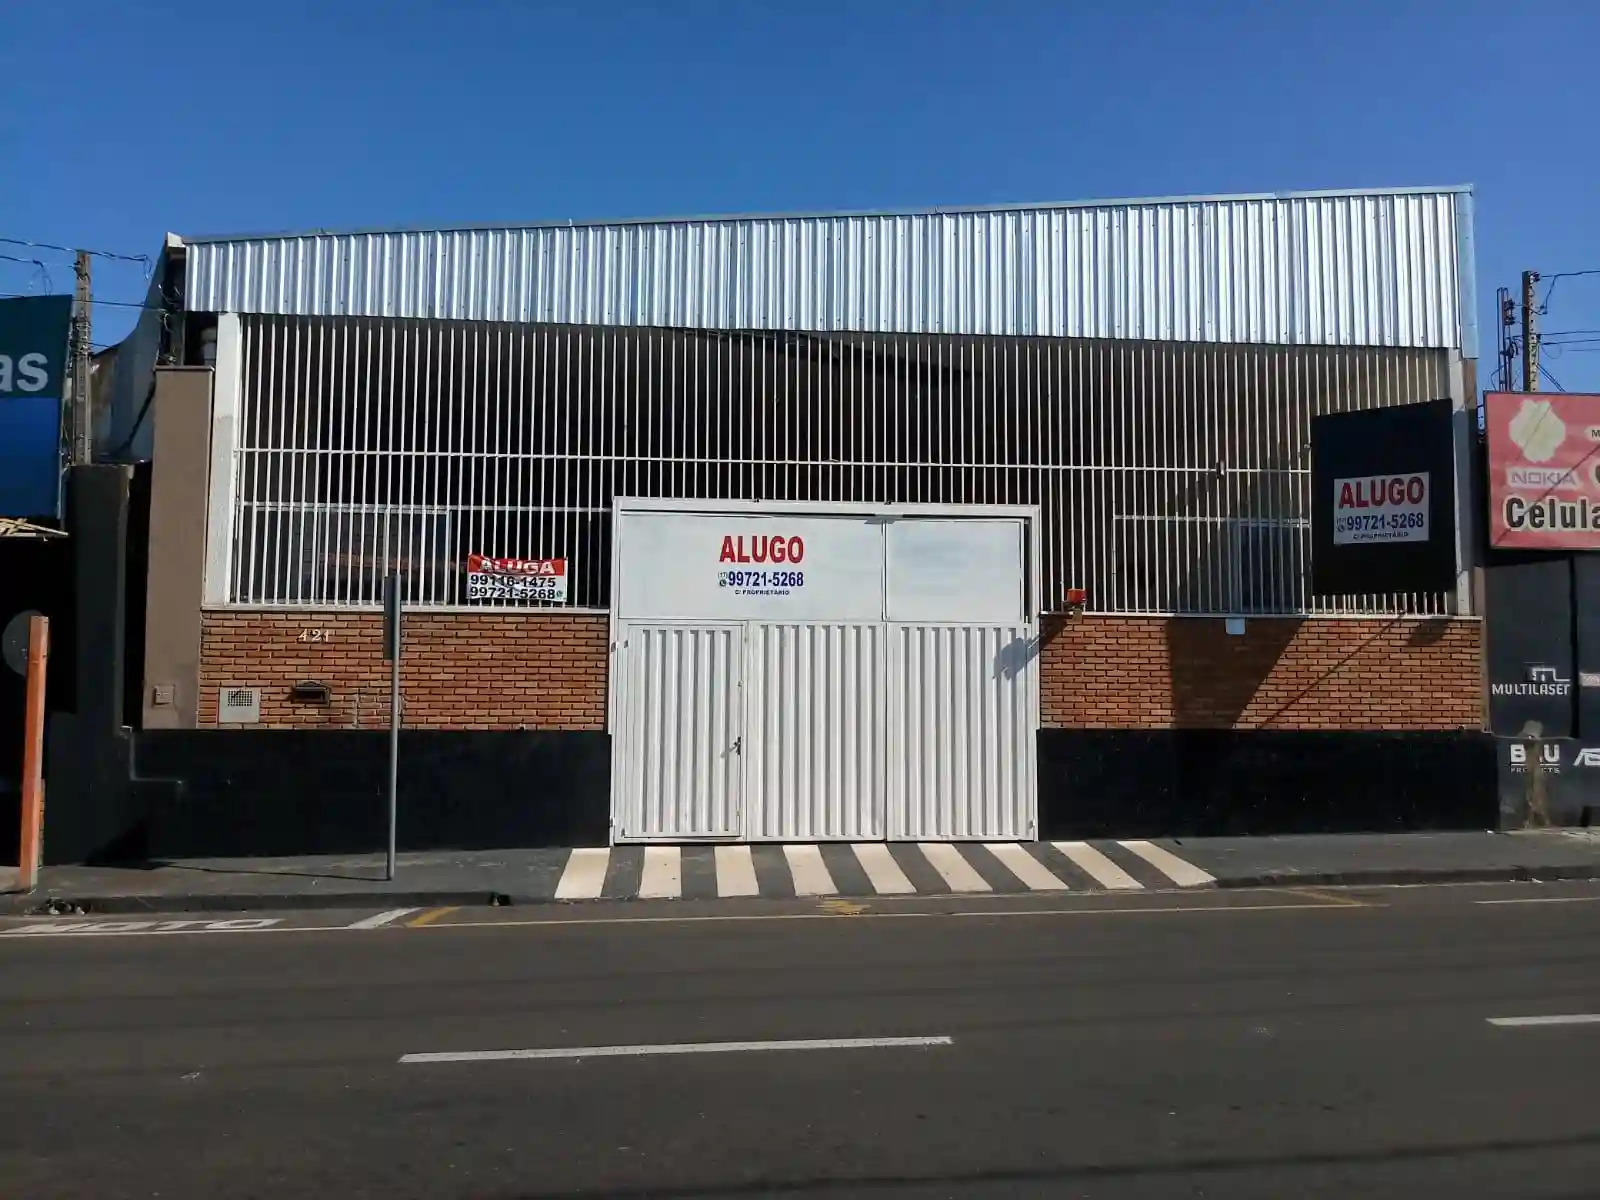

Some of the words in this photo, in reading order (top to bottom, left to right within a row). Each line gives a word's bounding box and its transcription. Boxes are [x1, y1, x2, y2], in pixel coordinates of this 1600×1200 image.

[1511, 471, 1576, 485] NOKIA
[1339, 476, 1425, 509] ALUGO
[1346, 512, 1424, 531] 99721-5268
[719, 535, 804, 564] ALUGO
[470, 574, 556, 588] 99116-1475
[728, 571, 804, 587] 99721-5268
[470, 586, 556, 599] 99721-5268
[298, 628, 330, 642] 421
[1510, 744, 1560, 762] BU
